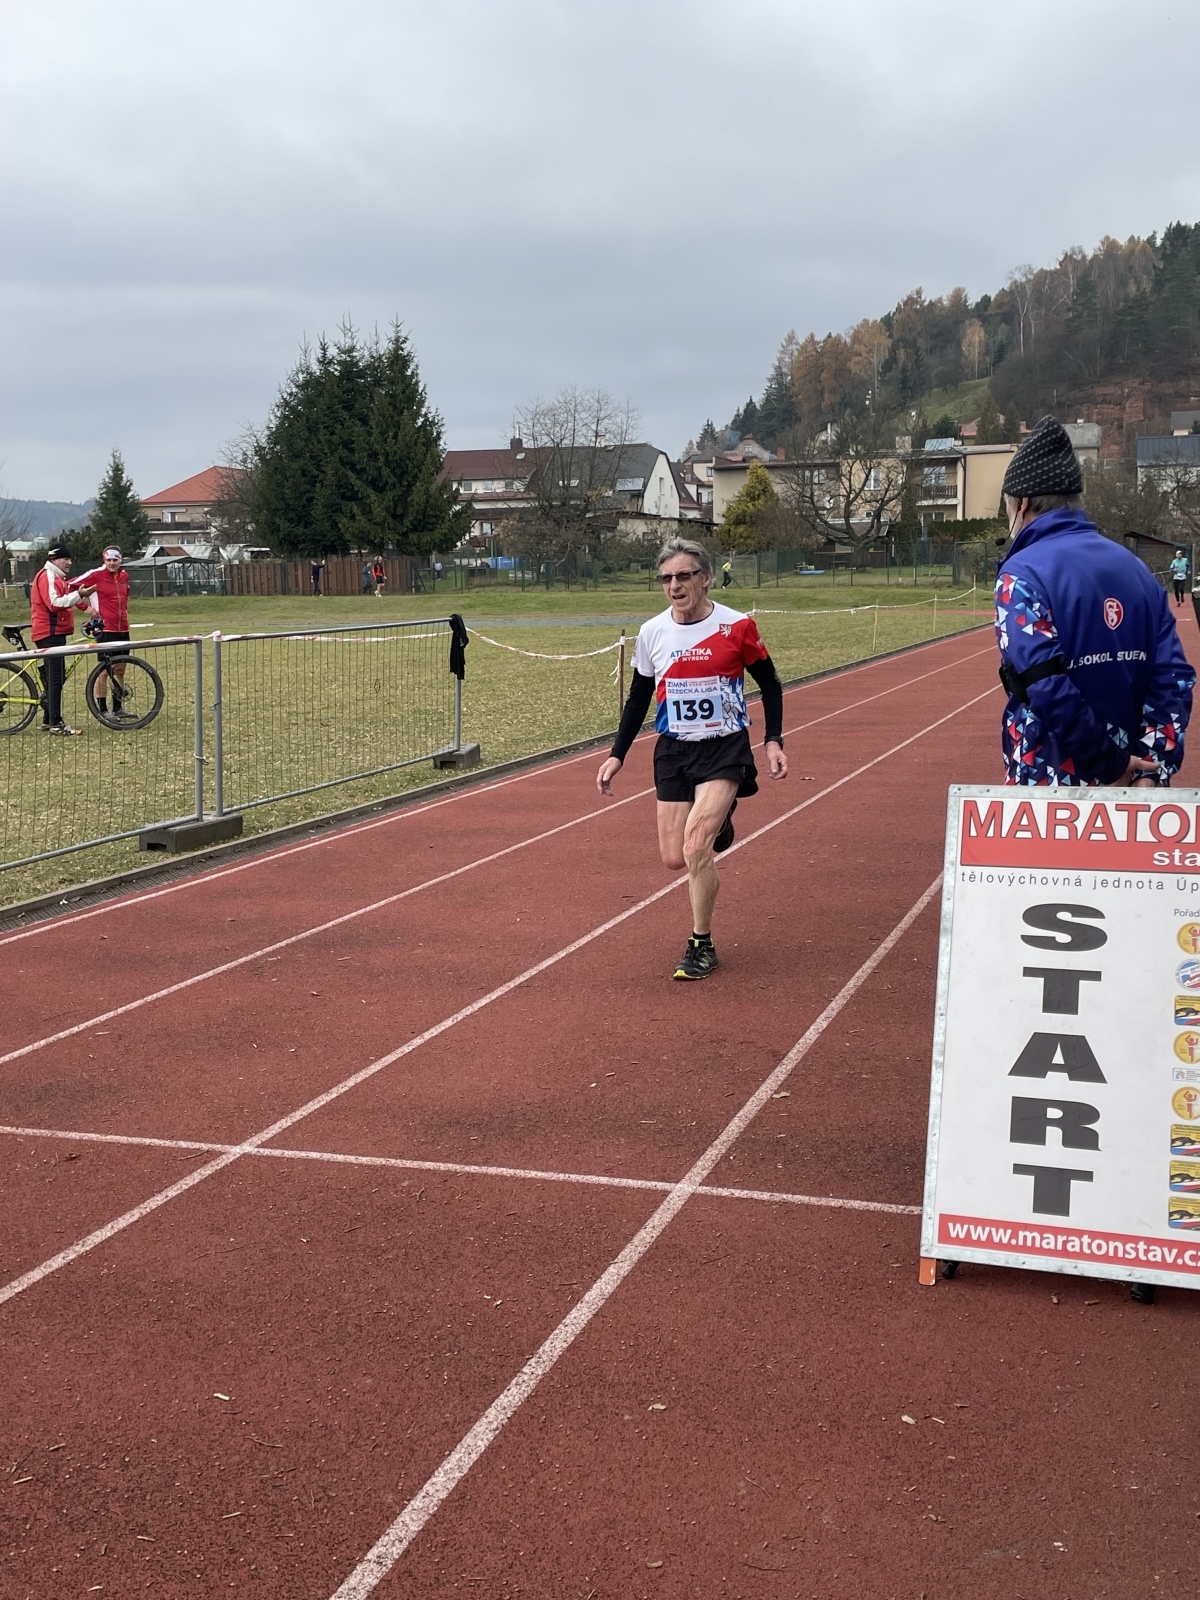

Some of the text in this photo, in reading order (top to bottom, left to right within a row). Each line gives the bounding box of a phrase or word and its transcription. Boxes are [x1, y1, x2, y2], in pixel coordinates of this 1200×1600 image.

[670, 648, 712, 657] ATLETIKA
[1078, 652, 1113, 666] SOKOL
[672, 698, 715, 721] 139
[963, 800, 1200, 844] MARATO
[961, 871, 1199, 894] tělovýchovná jednota Úp
[1007, 903, 1108, 1217] START
